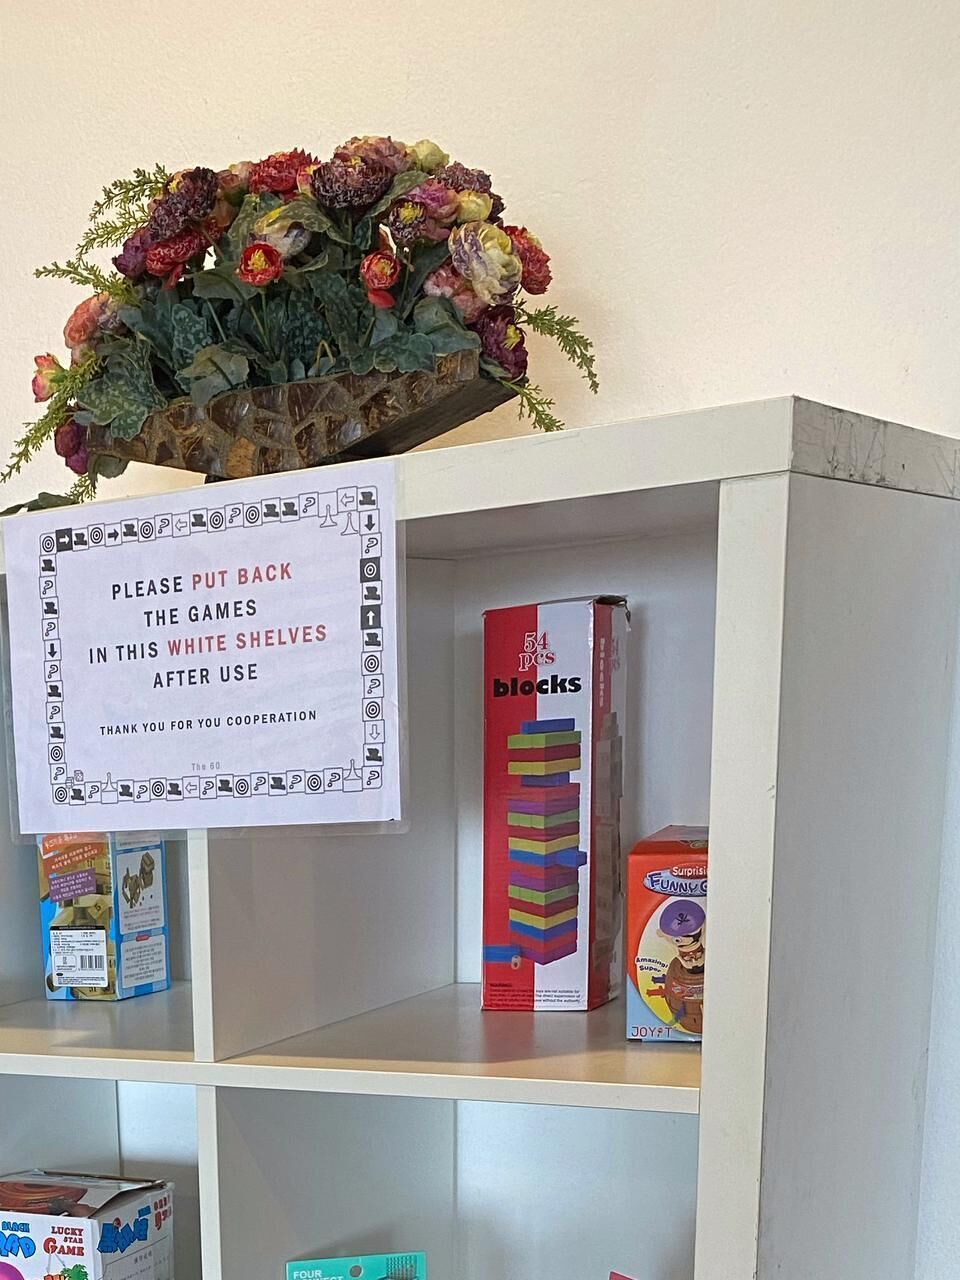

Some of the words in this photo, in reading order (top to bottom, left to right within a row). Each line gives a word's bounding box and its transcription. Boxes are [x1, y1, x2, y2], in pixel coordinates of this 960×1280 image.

[112, 576, 183, 600] PLEASE
[192, 570, 228, 590] PUT
[238, 562, 292, 585] BACK
[144, 608, 179, 627] THE
[188, 599, 257, 623] GAMES
[89, 646, 107, 664] IN
[116, 641, 159, 662] THIS
[167, 634, 226, 656] WHITE
[236, 624, 327, 650] SHELVES
[523, 631, 549, 653] 54
[518, 650, 556, 672] pcs
[153, 668, 210, 689] AFTER
[220, 663, 258, 682] USE
[493, 674, 582, 698] blocks
[100, 723, 138, 736] THANK
[142, 721, 165, 733] YOU
[170, 719, 193, 731] FOR
[197, 717, 221, 729] YOU
[227, 710, 317, 727] COOPERATION
[191, 763, 207, 772] The
[209, 761, 221, 771] 60
[648, 873, 698, 894] FUNNY
[636, 957, 668, 968] Amazing!
[639, 965, 662, 973] Super
[51, 1226, 84, 1236] LUCKY
[43, 1237, 85, 1256] GAME
[293, 1269, 322, 1280] FOUR
